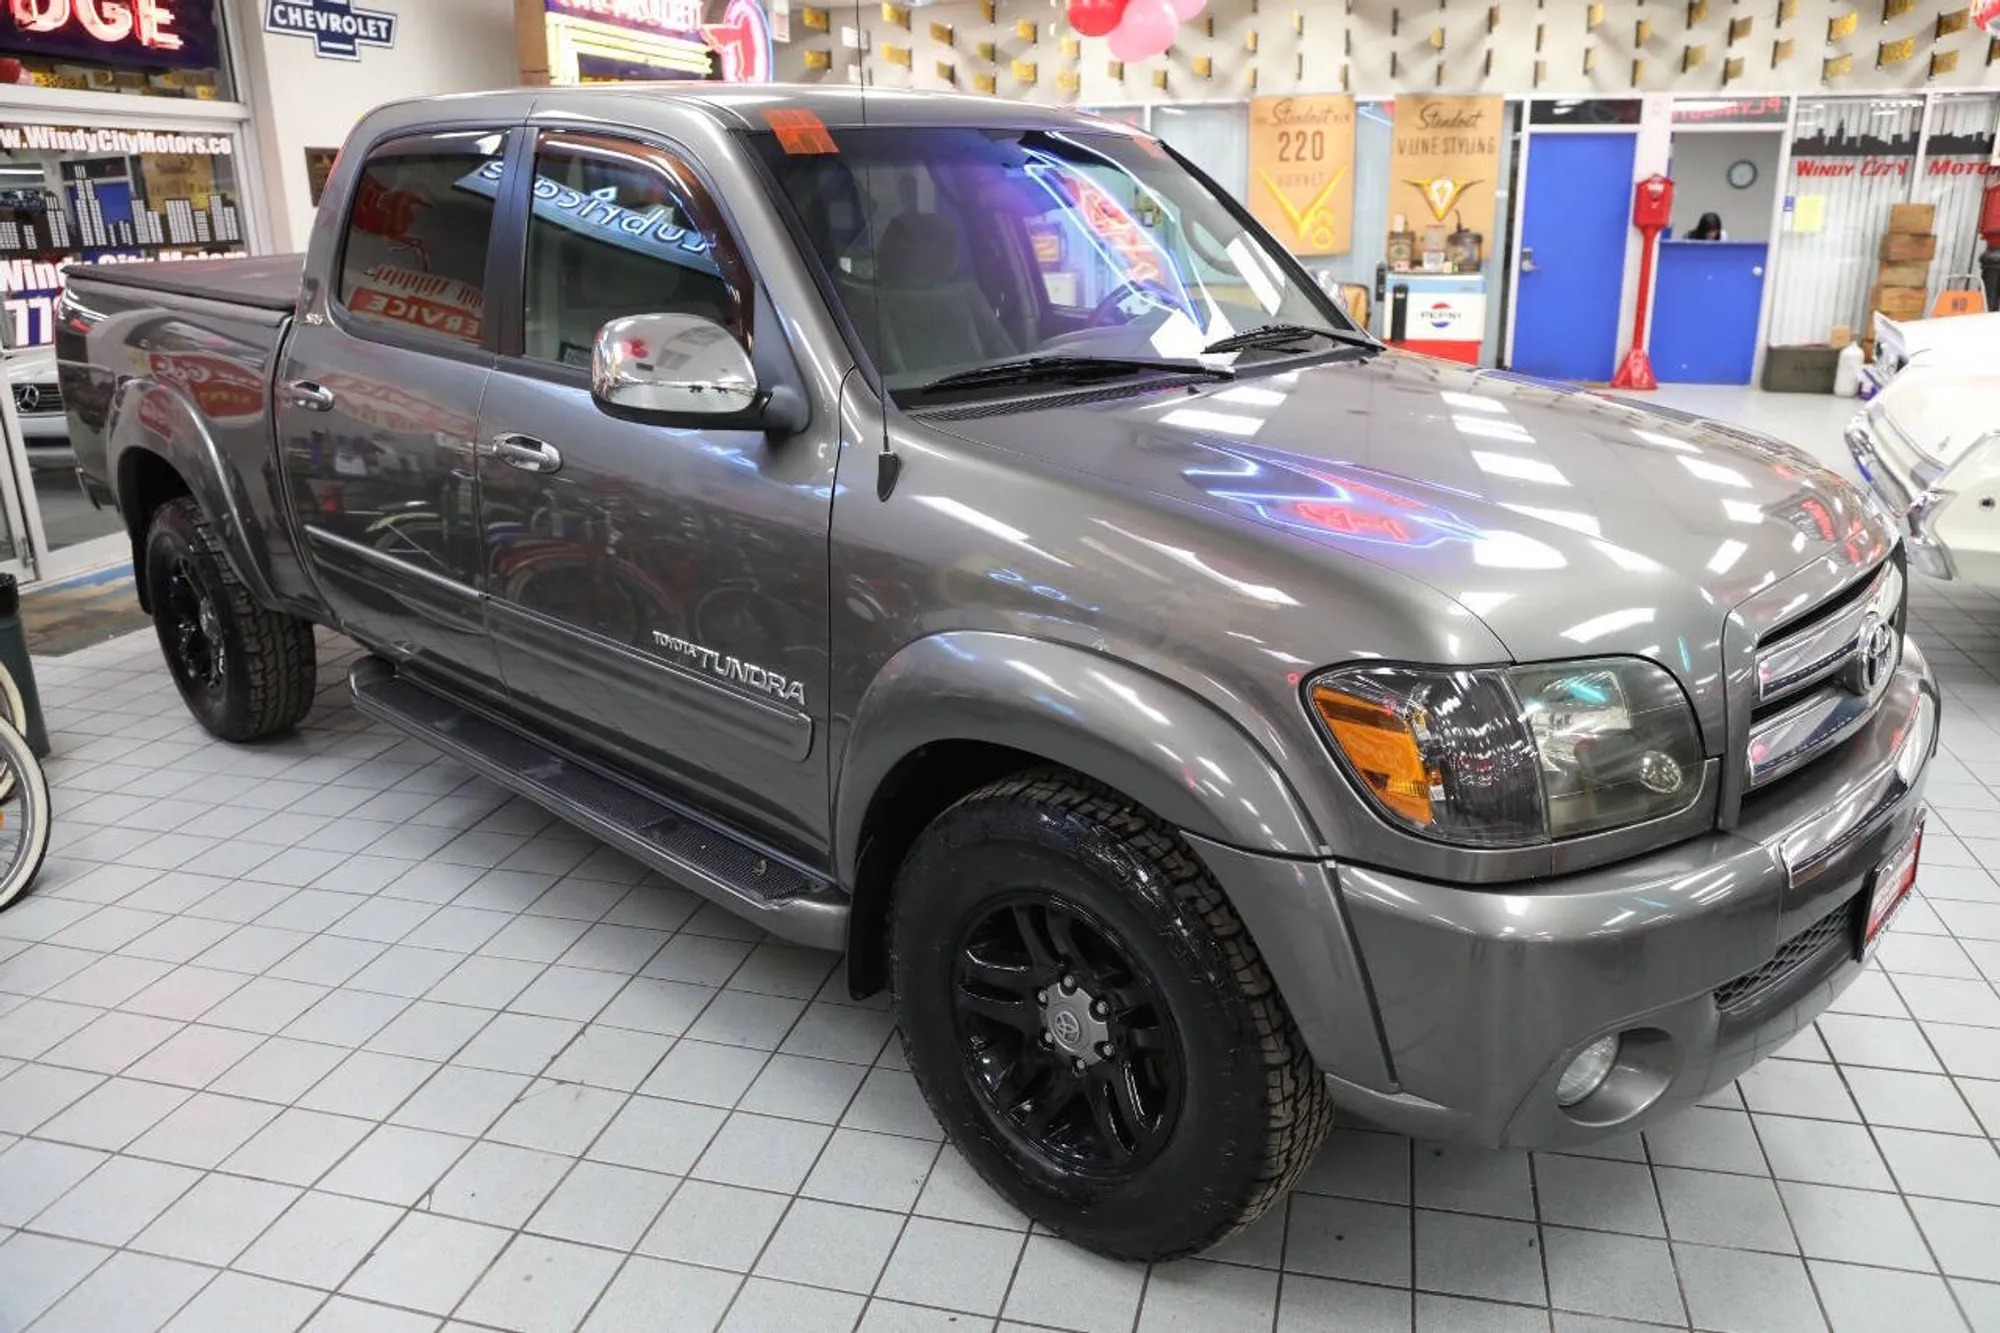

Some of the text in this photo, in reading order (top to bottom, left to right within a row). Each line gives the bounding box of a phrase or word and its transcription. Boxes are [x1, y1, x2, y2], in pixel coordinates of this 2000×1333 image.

[273, 4, 389, 39] CHEVROLET
[1278, 130, 1324, 162] 220
[652, 630, 805, 706] TOYOTA TUNDRA
